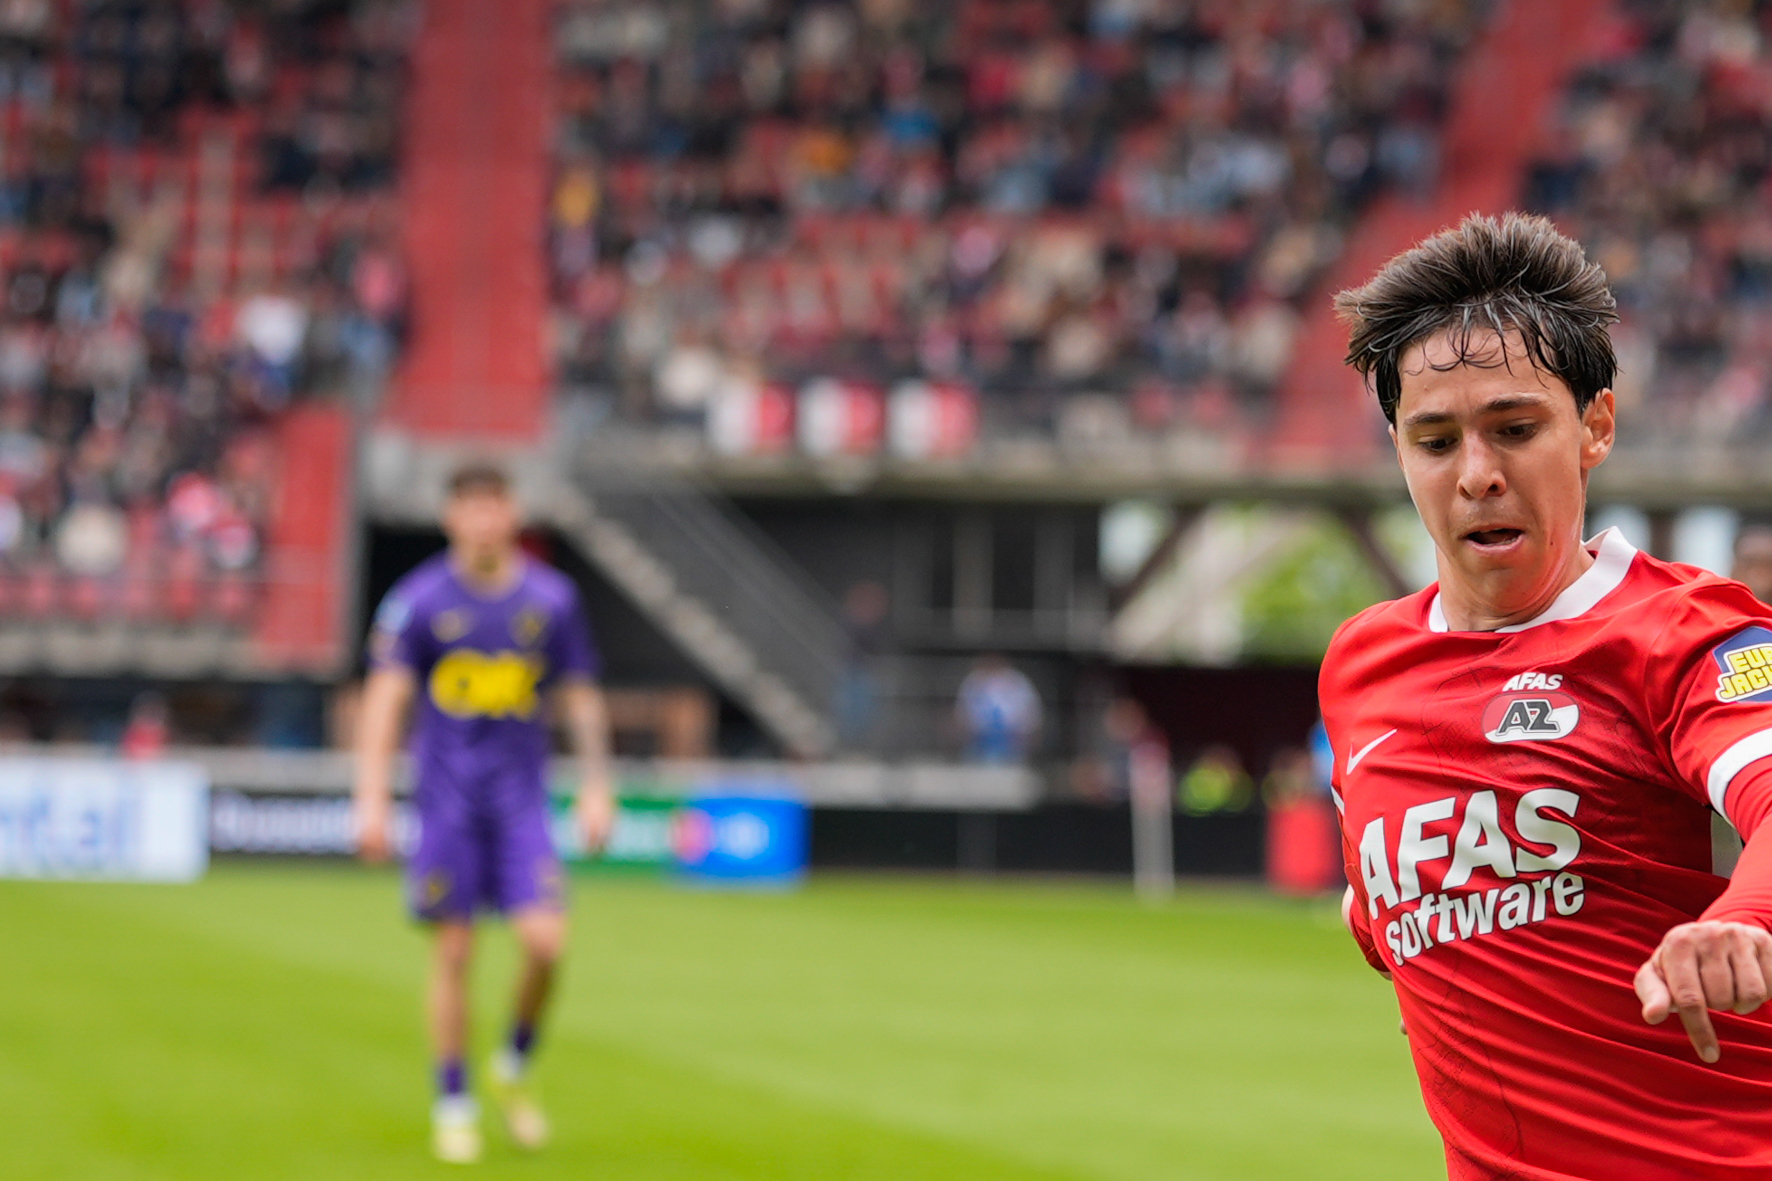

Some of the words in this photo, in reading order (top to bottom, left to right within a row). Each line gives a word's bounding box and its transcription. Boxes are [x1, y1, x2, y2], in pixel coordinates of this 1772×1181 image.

[1501, 672, 1563, 692] AFAS
[1496, 699, 1560, 735] AZ
[1359, 787, 1582, 920] AFAS
[1385, 871, 1585, 966] software
